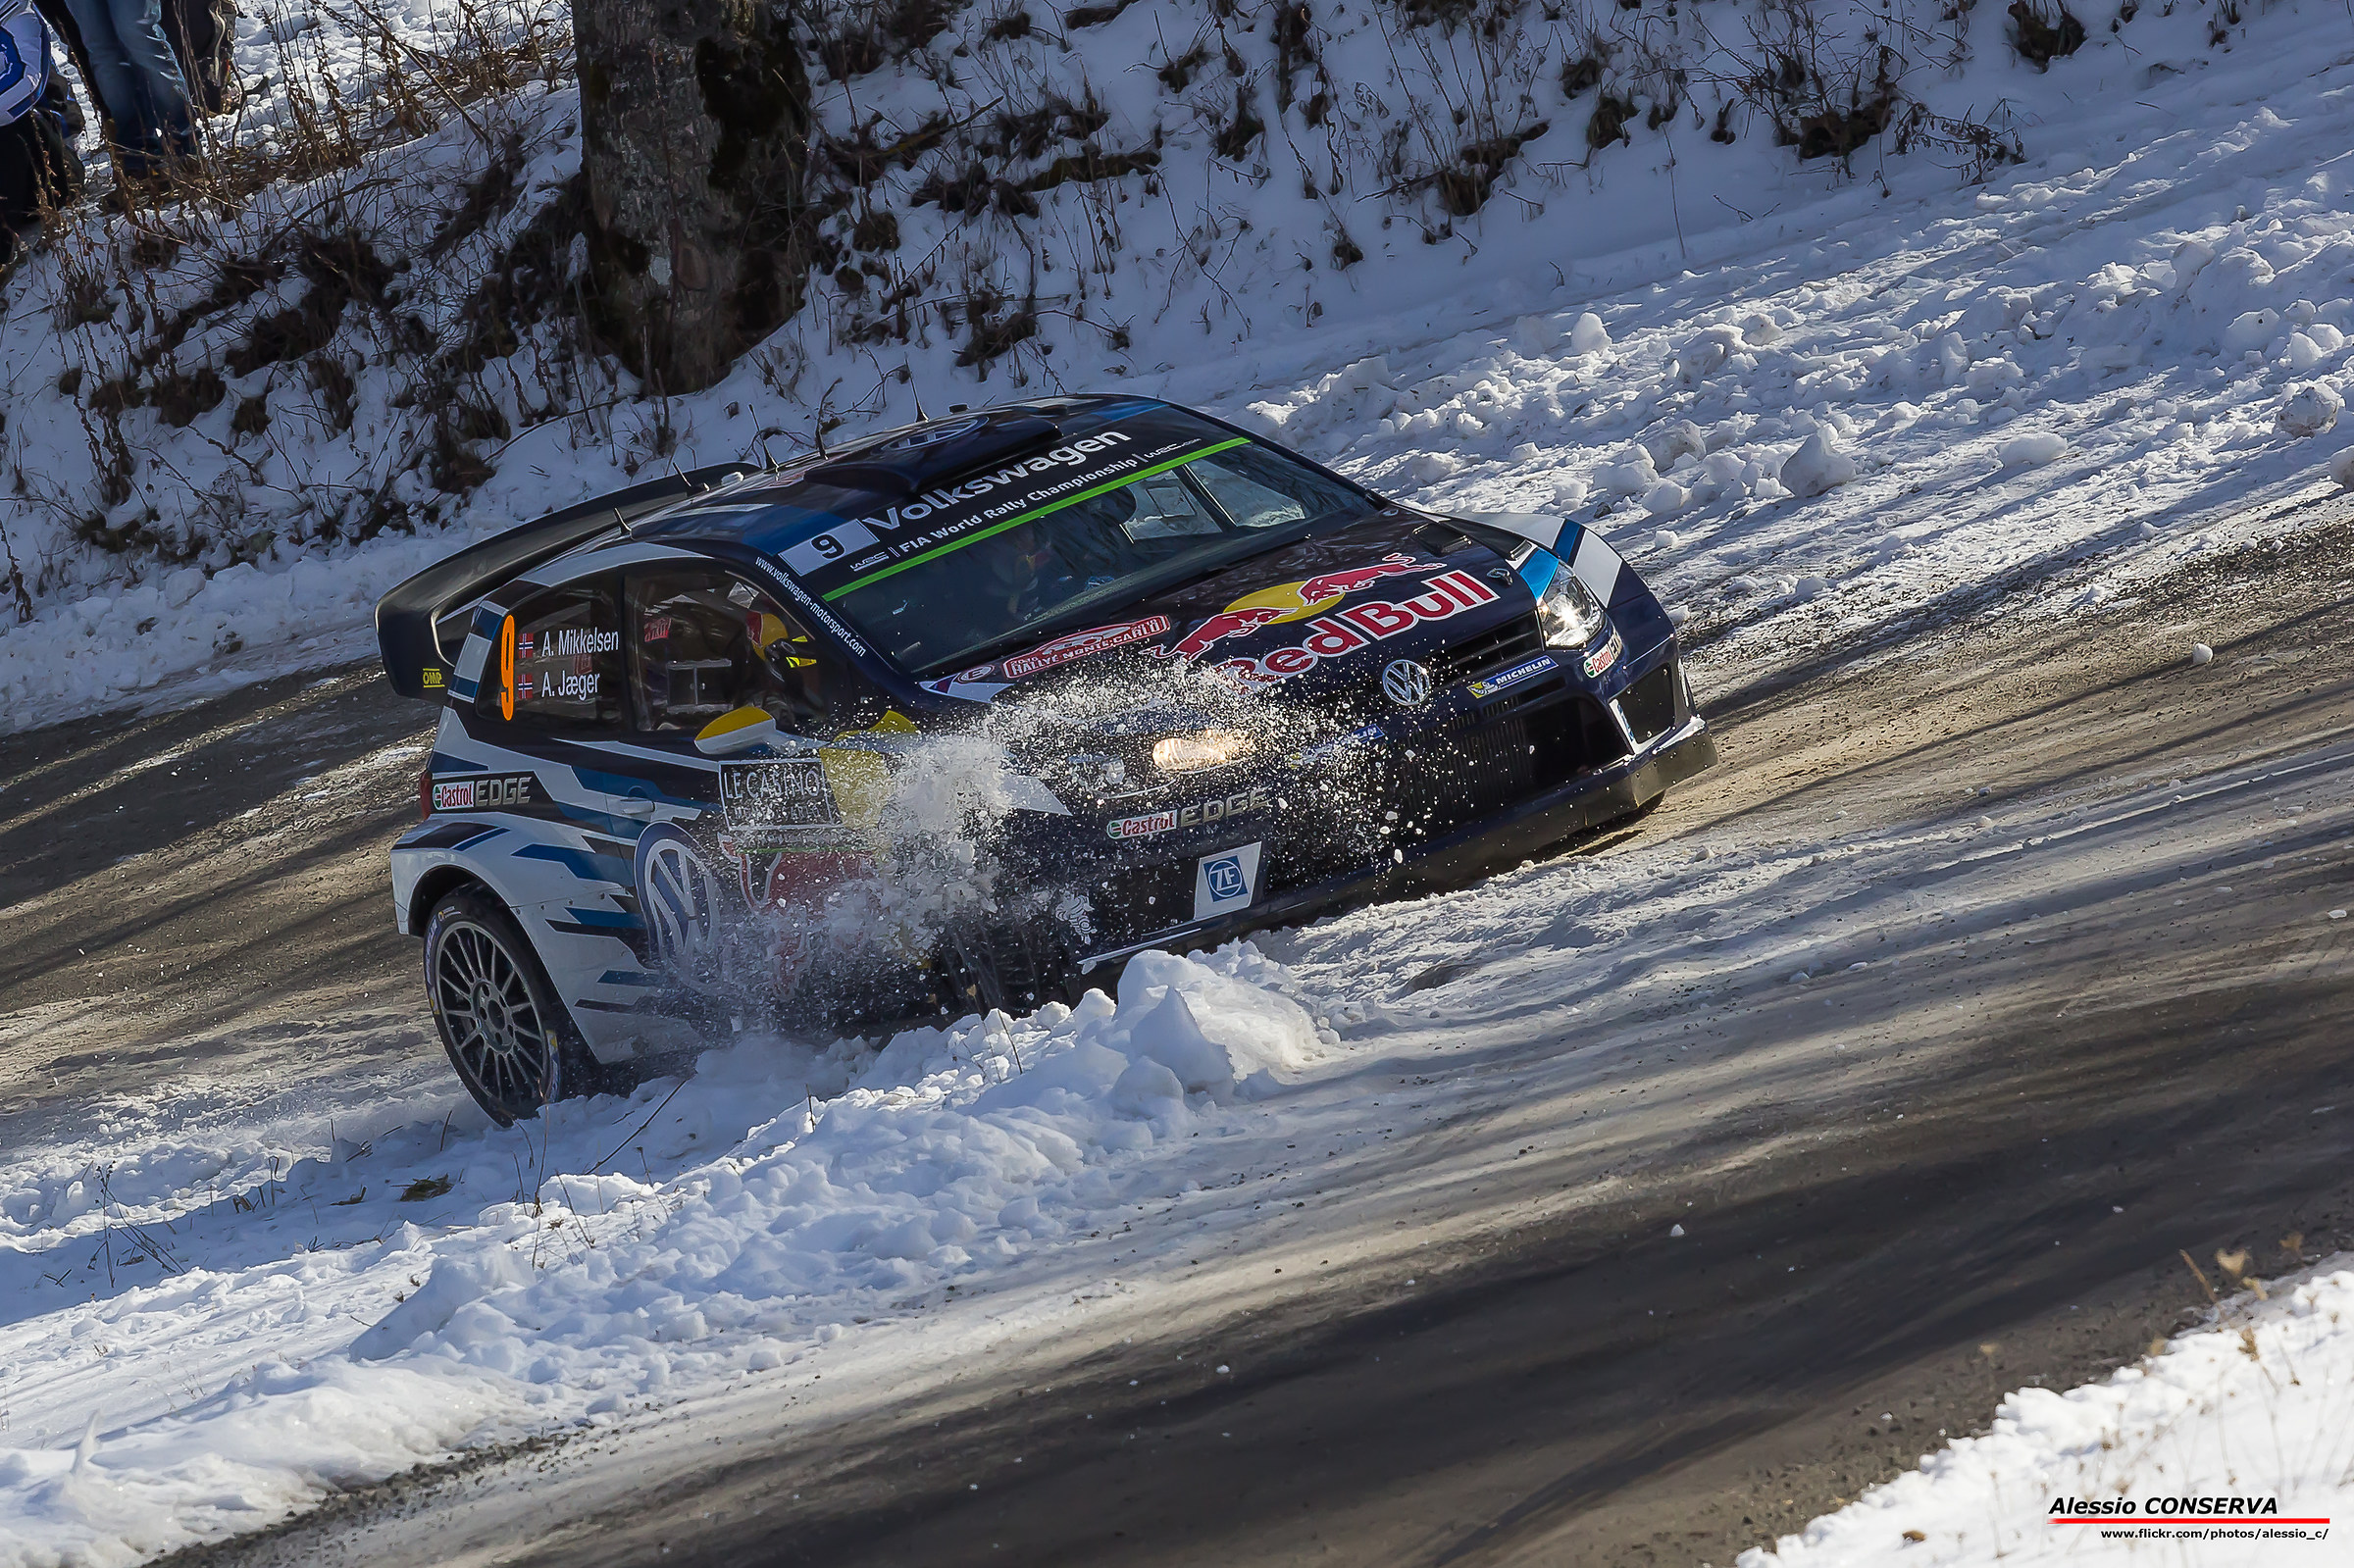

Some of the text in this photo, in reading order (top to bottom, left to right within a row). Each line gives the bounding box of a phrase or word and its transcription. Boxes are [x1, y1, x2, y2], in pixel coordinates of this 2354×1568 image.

[861, 430, 1132, 531] Volkswagen
[898, 536, 932, 553] FIA
[930, 512, 983, 539] World
[983, 498, 1027, 521] Rally
[1027, 458, 1138, 502] Championship
[810, 533, 845, 560] 9
[755, 556, 867, 658] www.volkswagen-motorsport.com
[1336, 570, 1501, 640] Bull
[541, 632, 555, 657] A.
[558, 627, 620, 655] Mikkelsen
[501, 615, 515, 721] 9
[1496, 658, 1551, 684] MICHELIN
[1592, 646, 1613, 674] Castrol
[423, 672, 442, 684] OMP
[541, 670, 600, 700] A. Jæger
[440, 777, 532, 808] Castrol EDGE
[724, 768, 821, 799] LE CASINO
[1122, 785, 1272, 836] Castrol EDGE
[1210, 867, 1241, 892] ZF
